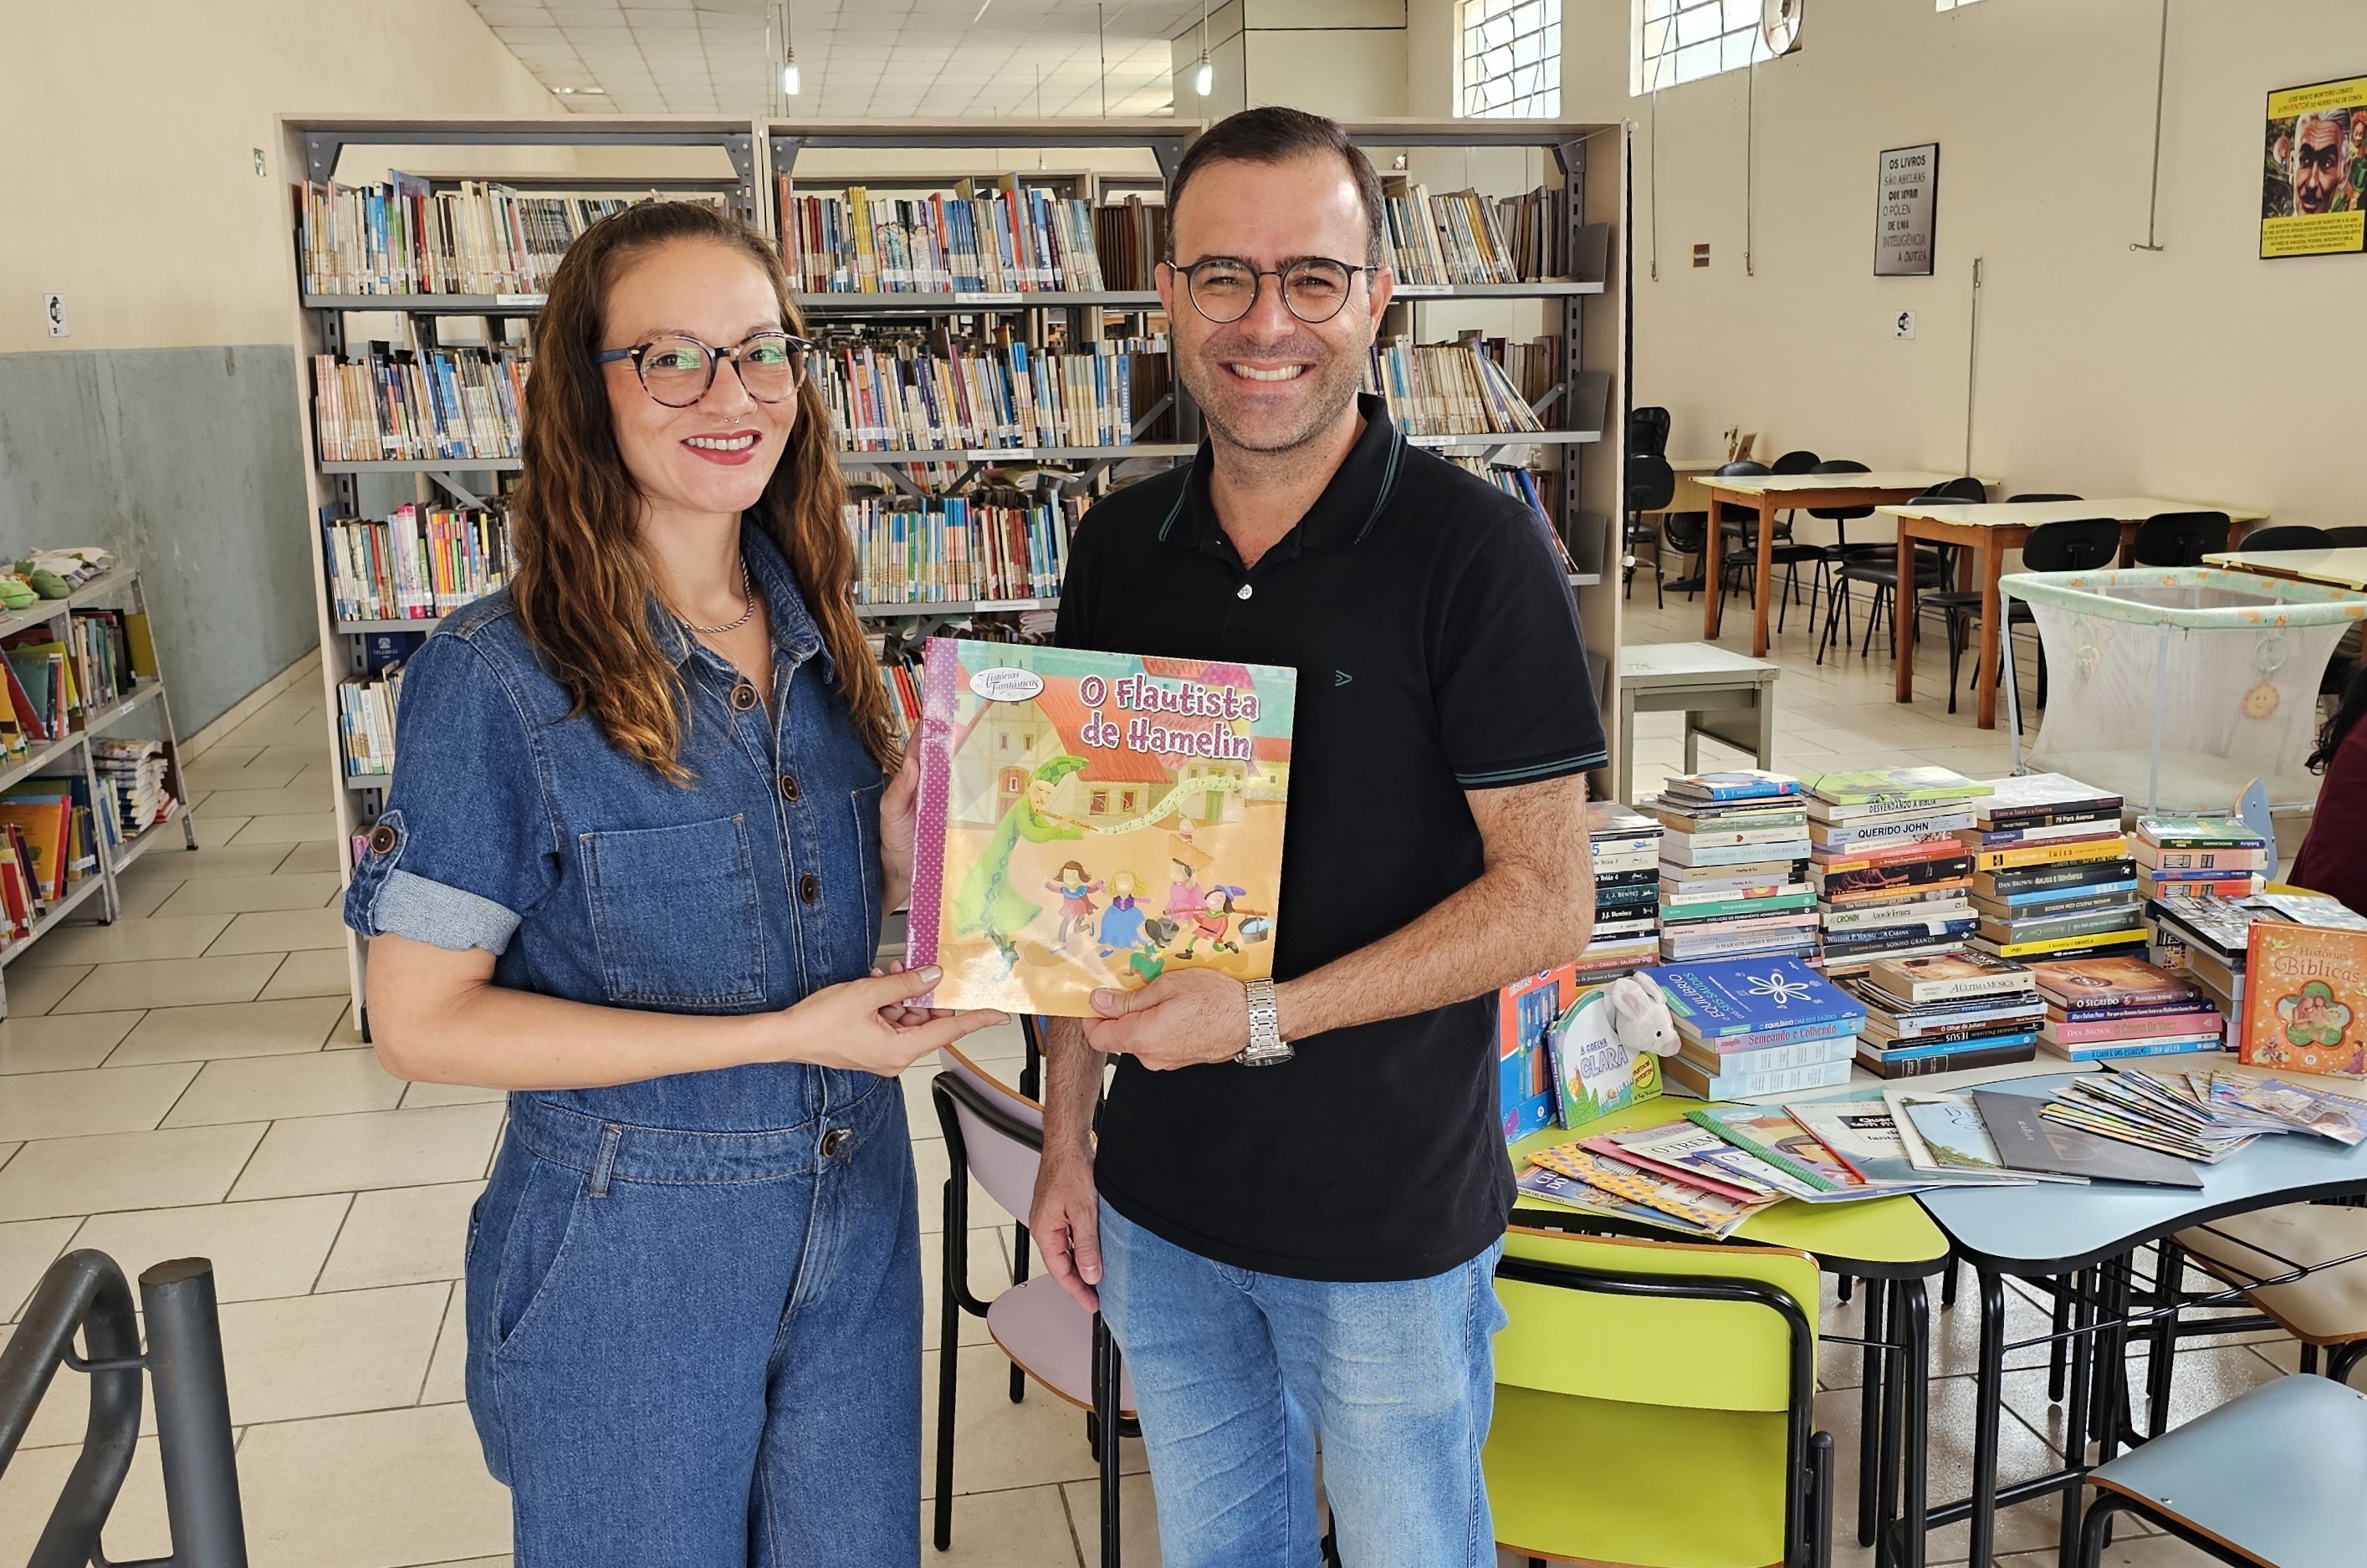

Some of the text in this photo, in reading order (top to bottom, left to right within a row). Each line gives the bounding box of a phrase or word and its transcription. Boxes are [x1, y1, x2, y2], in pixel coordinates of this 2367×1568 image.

[2282, 102, 2310, 112] INVENTOR
[1889, 155, 1926, 170] OS LIVROS
[1884, 171, 1926, 186] SÃO ABELHAS
[1888, 190, 1899, 201] QUE
[1883, 203, 1911, 217] O PÓLEN
[1888, 221, 1895, 231] DE
[1883, 233, 1926, 248] INTELIGÊNCIA
[1897, 250, 1927, 263] A OUTRA
[977, 671, 1020, 689] Histórias
[987, 678, 1040, 697] Fantásticas
[1080, 672, 1261, 722] O Flautista
[1081, 711, 1253, 762] de Hamelin
[2063, 815, 2074, 823] Park
[1858, 825, 1901, 839] QUERIDO
[1902, 822, 1930, 834] JOHN
[1592, 843, 1601, 856] 5
[1741, 845, 1797, 857] COMER REZAR AMAR
[2049, 847, 2073, 858] luísa
[2095, 883, 2119, 893] YVES
[1837, 914, 1859, 923] CRONIN
[1827, 934, 1851, 942] WILLIAM
[1886, 937, 1935, 948] SONHO GRANDE
[2299, 947, 2349, 961] Histórias
[2274, 956, 2360, 983] Bíblicas
[1684, 972, 1715, 1001] SAÚDES
[1950, 979, 2015, 993] A ÚLTIMA MÚSICA
[1669, 973, 1725, 1018] EQUILÍBRIO
[2077, 998, 2119, 1009] O SEGREDO
[1764, 1019, 1794, 1029] EQUILÍBRIO
[1817, 1013, 1837, 1022] SAÚDES
[1749, 1030, 1790, 1045] Semeando
[1799, 1024, 1837, 1038] Colhendo
[1945, 1031, 1969, 1042] JESUS
[2067, 1029, 2083, 1037] DAN
[2085, 1027, 2110, 1035] BROWN
[1580, 1038, 1608, 1056] A COELHA
[1580, 1044, 1629, 1079] CLARA
[1651, 1136, 1720, 1155] O TREM
[1546, 1177, 1569, 1190] DO
